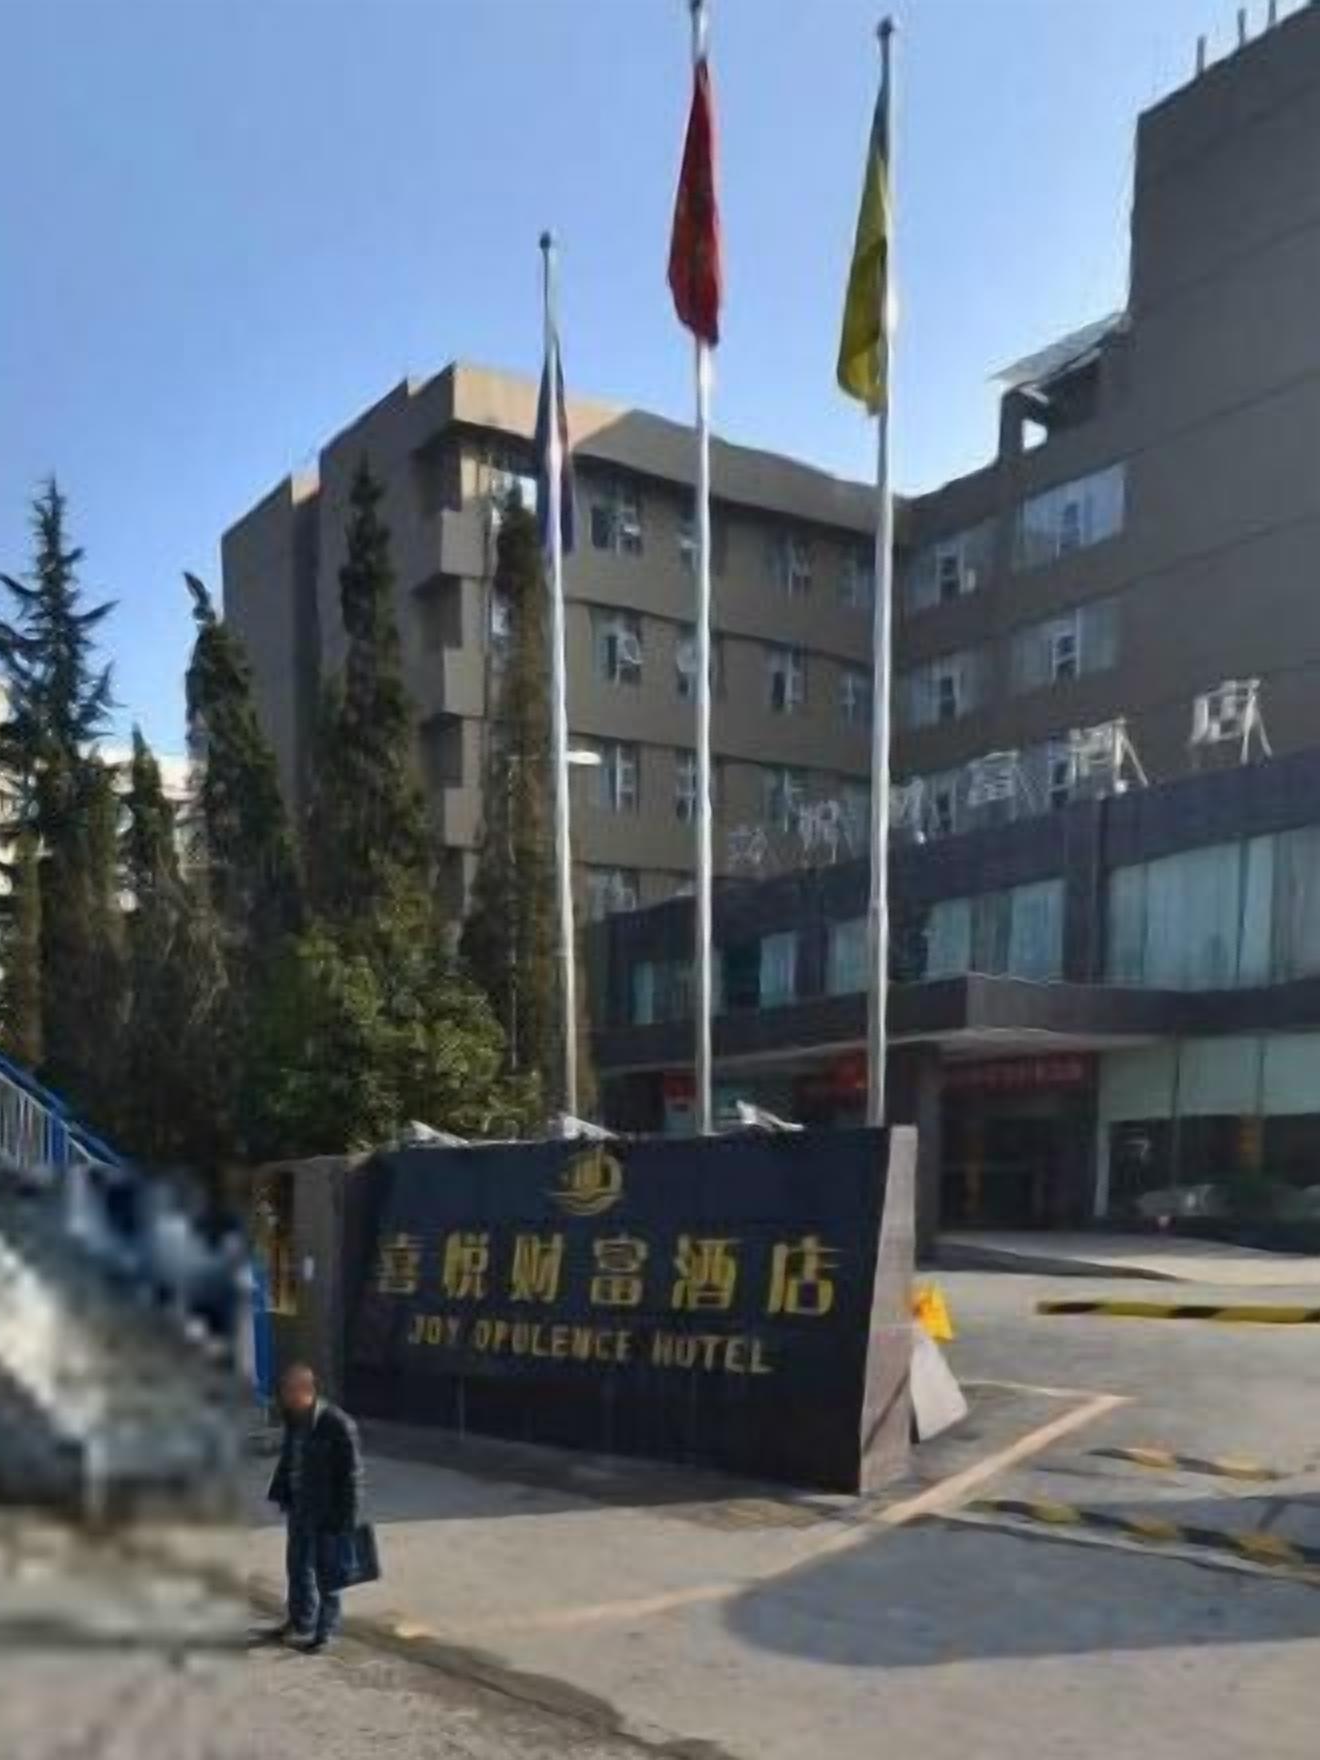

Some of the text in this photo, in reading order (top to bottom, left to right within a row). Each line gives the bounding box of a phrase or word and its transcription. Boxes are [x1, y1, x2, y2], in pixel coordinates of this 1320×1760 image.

[377, 1232, 842, 1316] 喜悦财富酒店
[408, 1314, 773, 1374] JOY OPULENCE HOTEL
